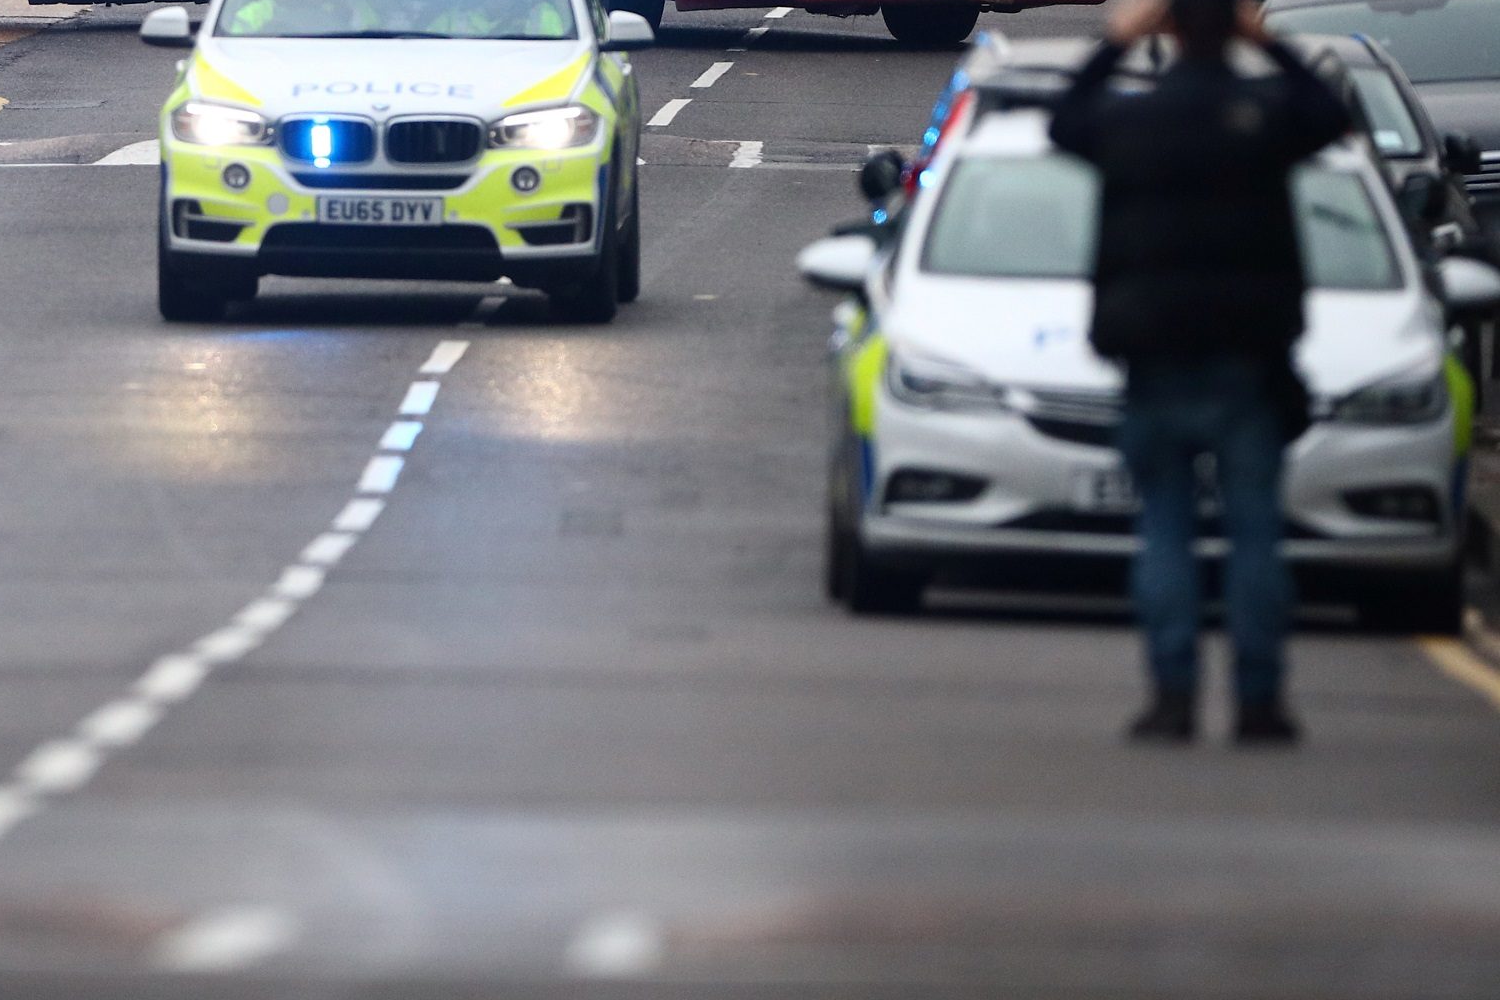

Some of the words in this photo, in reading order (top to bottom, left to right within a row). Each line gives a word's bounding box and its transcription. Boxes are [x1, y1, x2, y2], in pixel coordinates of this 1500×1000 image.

[292, 81, 476, 100] POLICE
[327, 199, 385, 221] EU65
[391, 200, 433, 221] DYV
